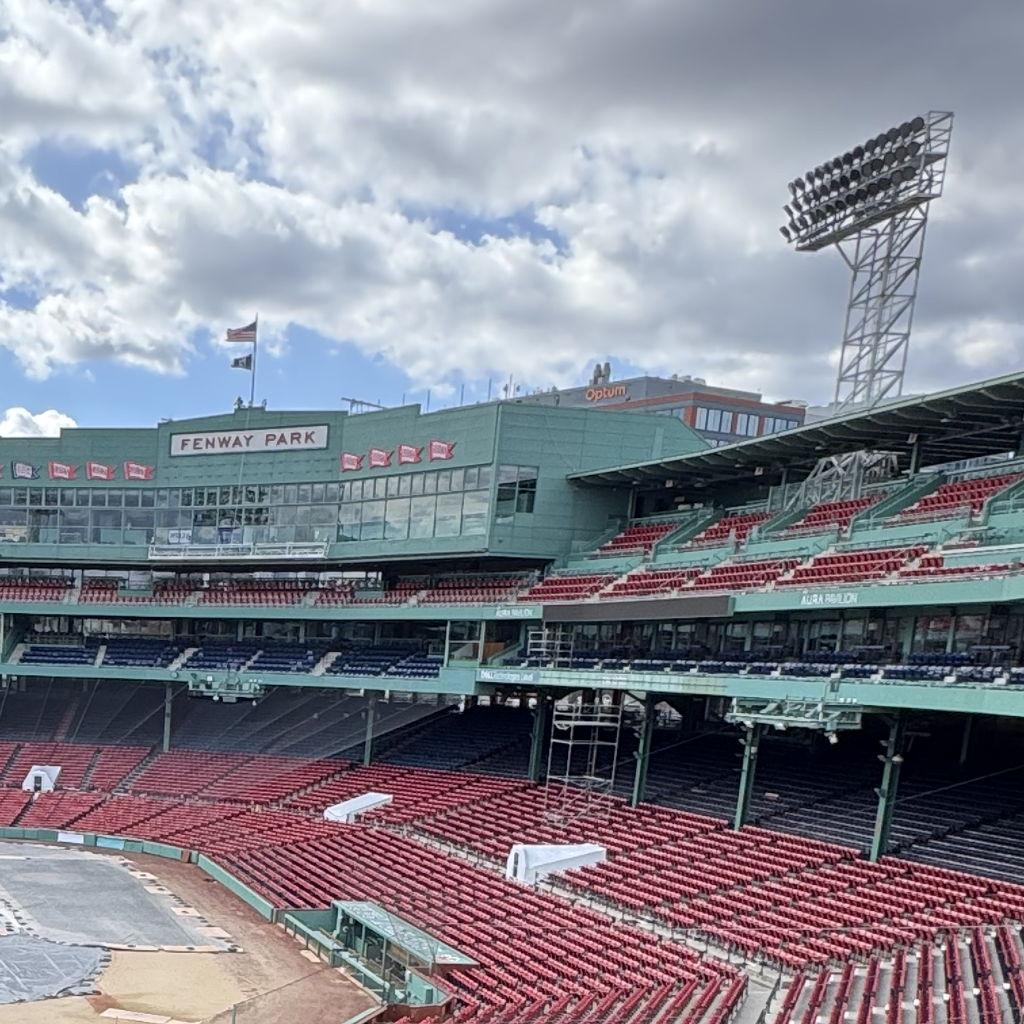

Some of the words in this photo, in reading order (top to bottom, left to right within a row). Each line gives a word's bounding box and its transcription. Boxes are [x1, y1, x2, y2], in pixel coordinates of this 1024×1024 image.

[586, 386, 626, 405] Optum
[181, 435, 254, 451] FENWAY
[265, 431, 316, 447] PARK
